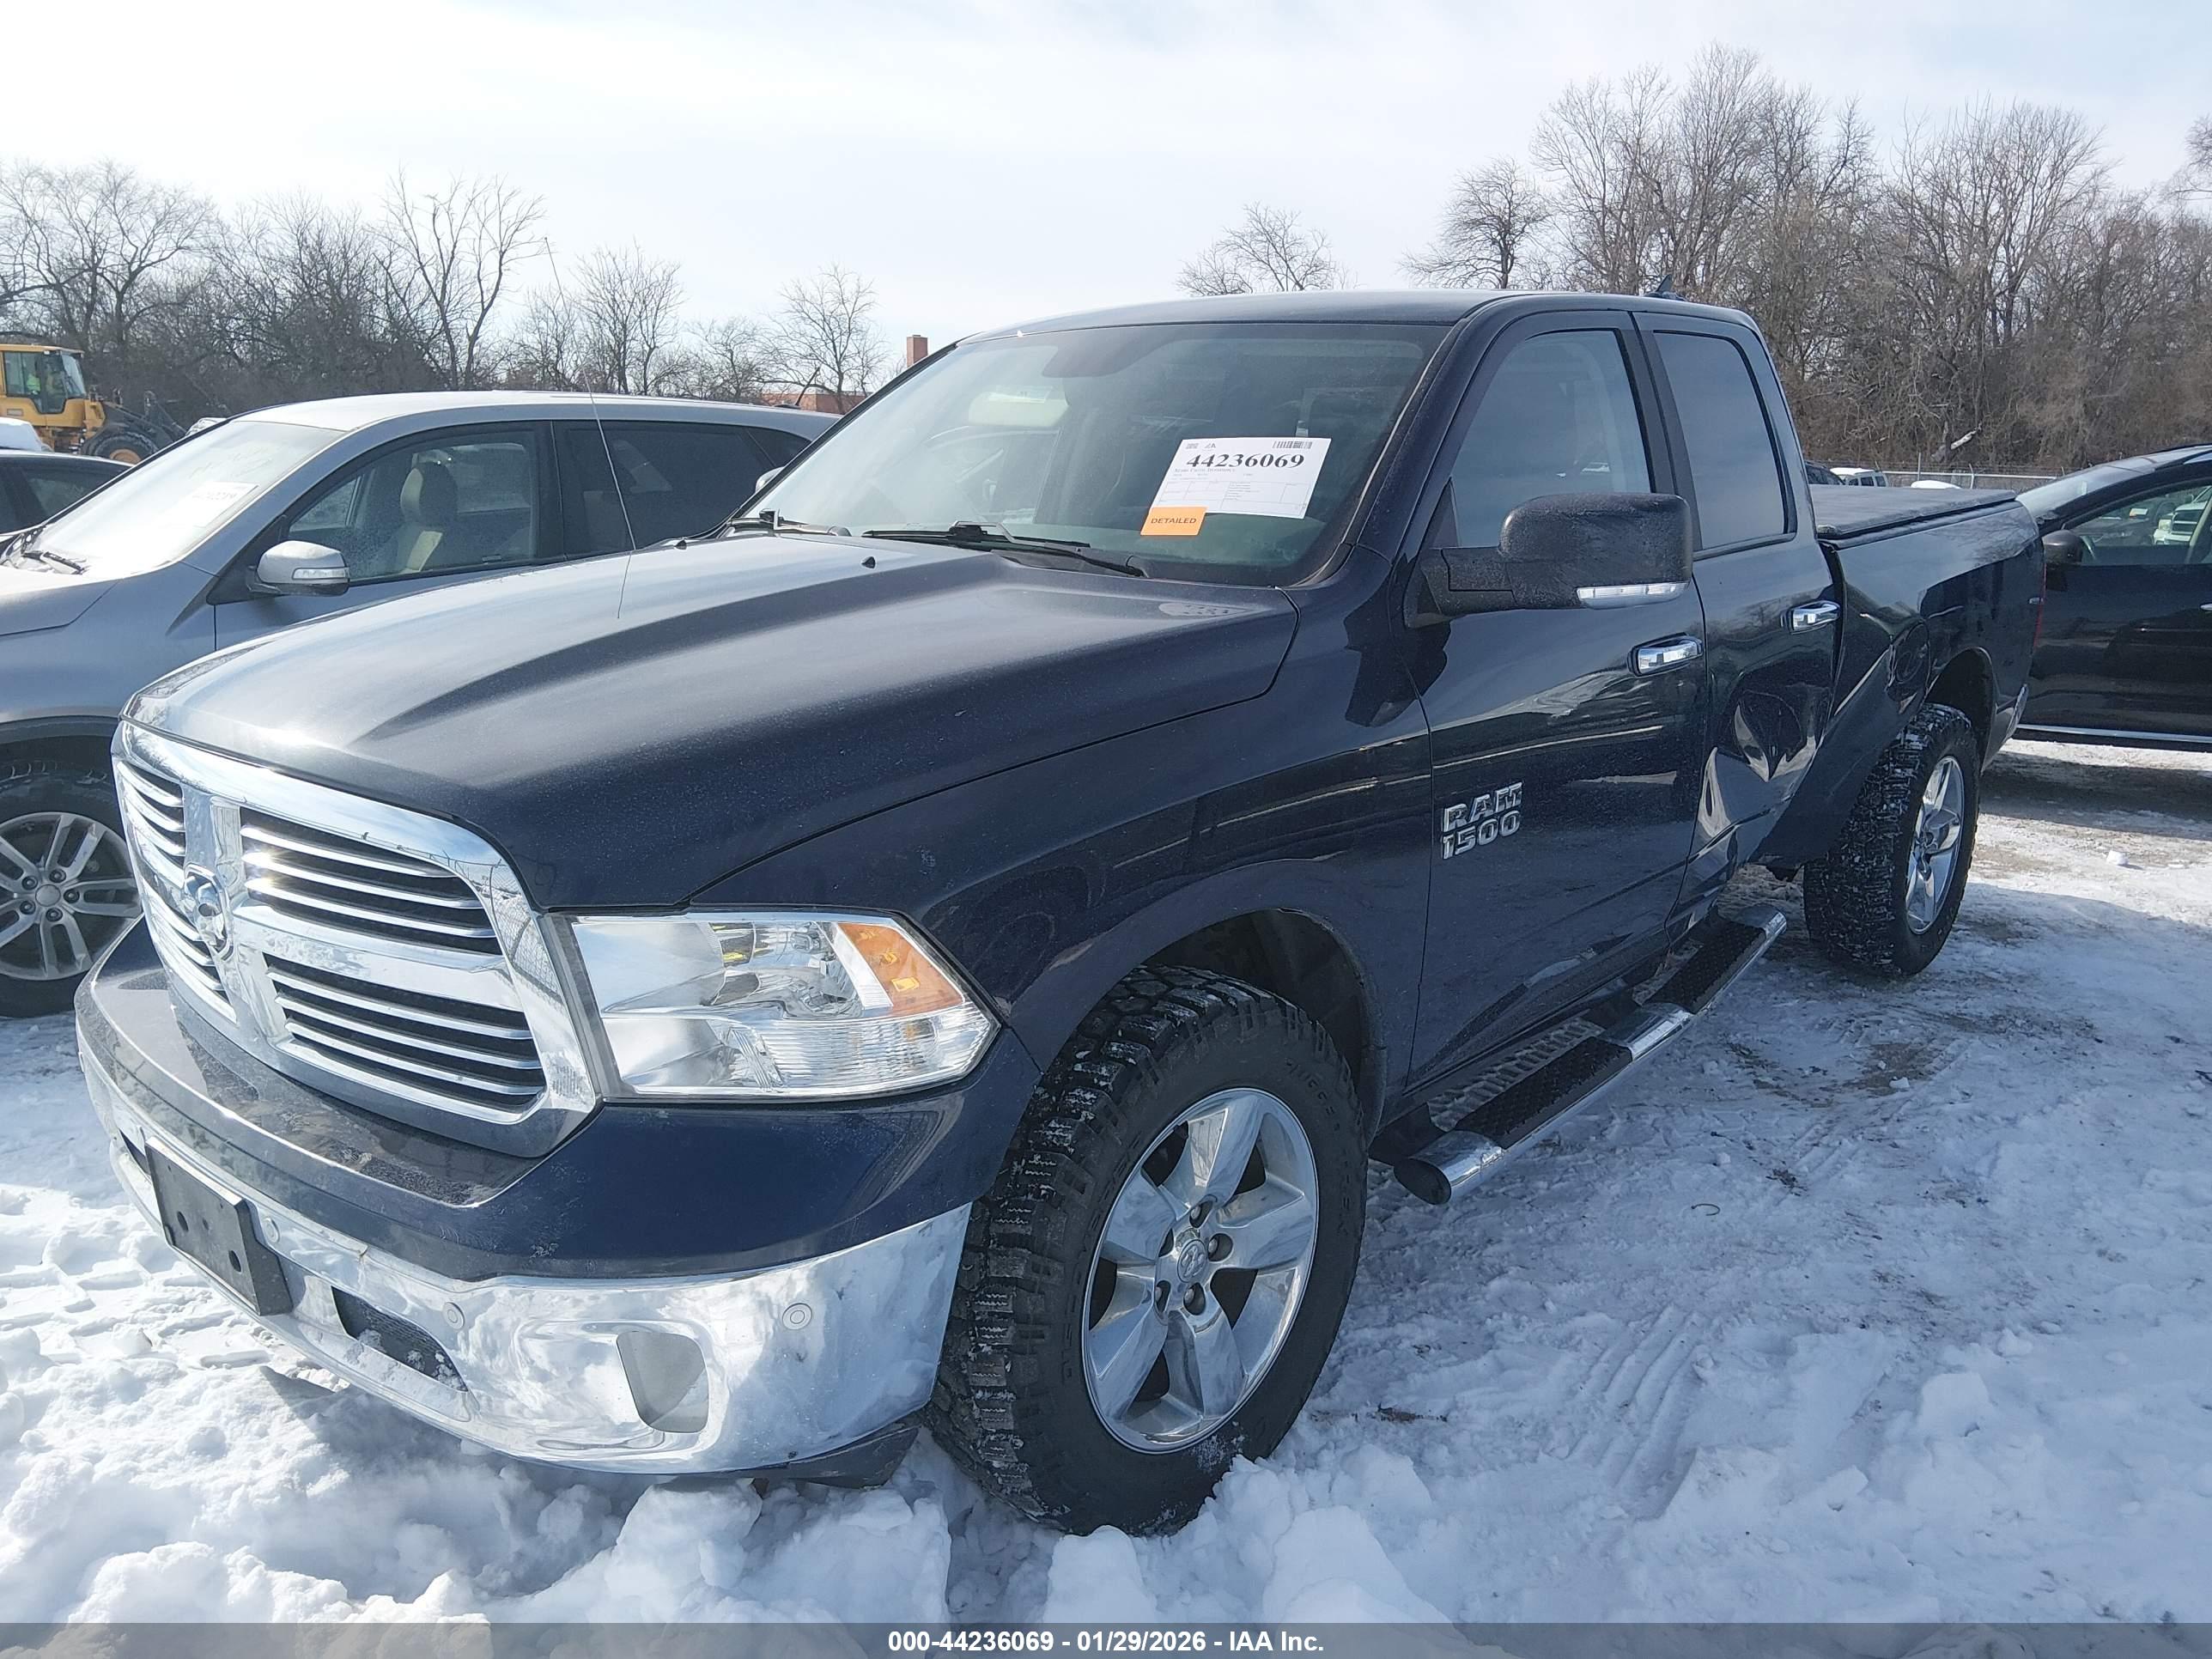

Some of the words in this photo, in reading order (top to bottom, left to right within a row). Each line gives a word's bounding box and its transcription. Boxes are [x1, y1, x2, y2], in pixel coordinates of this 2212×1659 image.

[1187, 453, 1304, 468] 44236069
[1443, 781, 1523, 833] RAM
[1441, 810, 1522, 860] 1500
